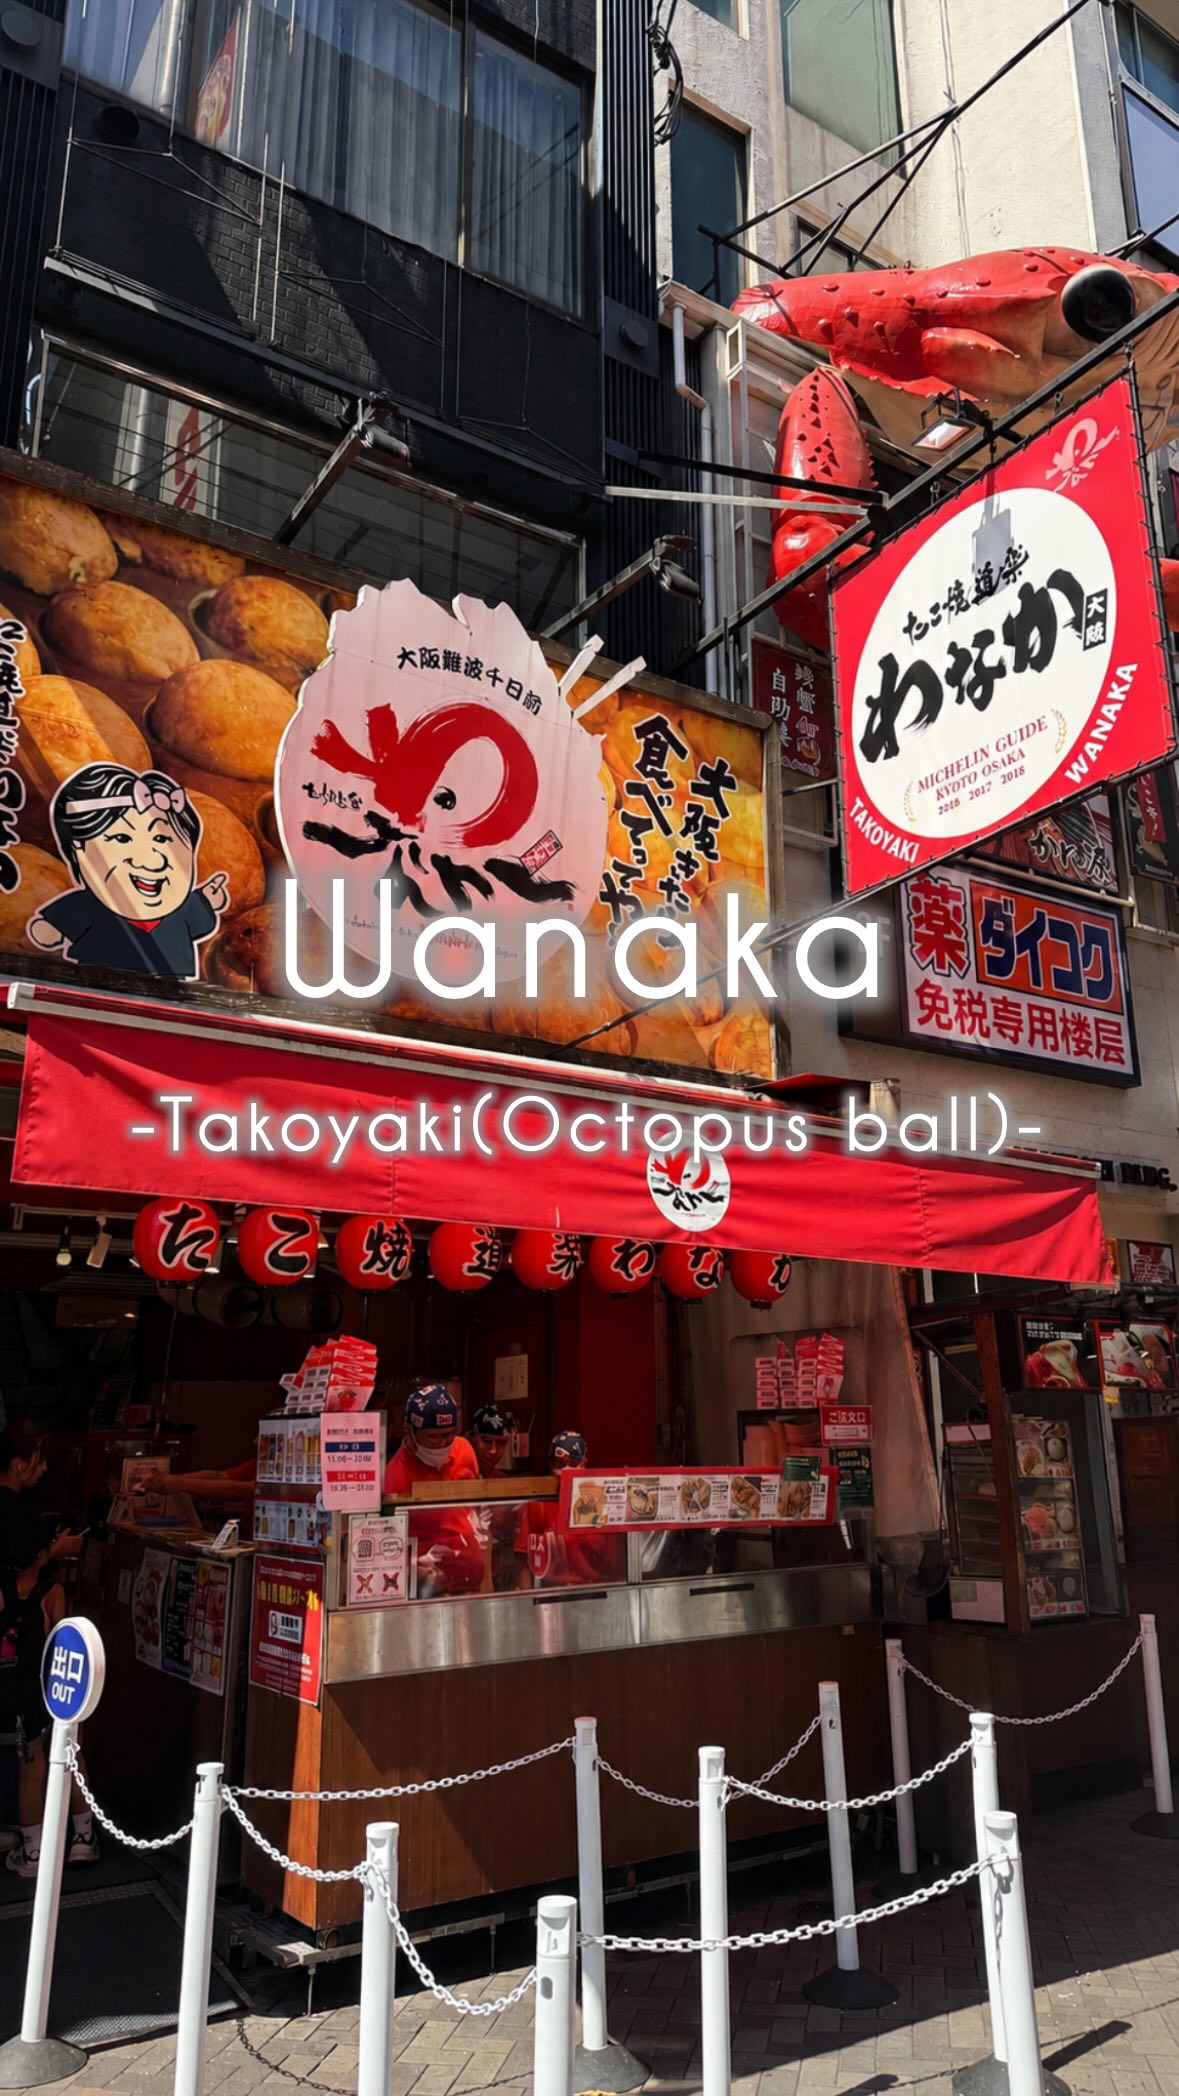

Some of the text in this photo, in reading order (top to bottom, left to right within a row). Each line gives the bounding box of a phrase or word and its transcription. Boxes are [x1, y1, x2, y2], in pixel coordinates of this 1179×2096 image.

[396, 645, 544, 717] 大阪難波千日前
[859, 568, 1086, 764] わなか
[916, 715, 1049, 795] MICHELIN GUIDE
[1063, 663, 1139, 785] WANAKA
[935, 746, 1027, 802] KYOTO OSAKA
[968, 781, 993, 801] 2017
[1000, 765, 1027, 786] 2018
[849, 796, 921, 865] TAKOYAKI
[909, 874, 968, 977] 薬
[981, 895, 1116, 1003] ダイコク
[50, 1645, 85, 1684] 出口
[51, 1681, 76, 1705] OUT
